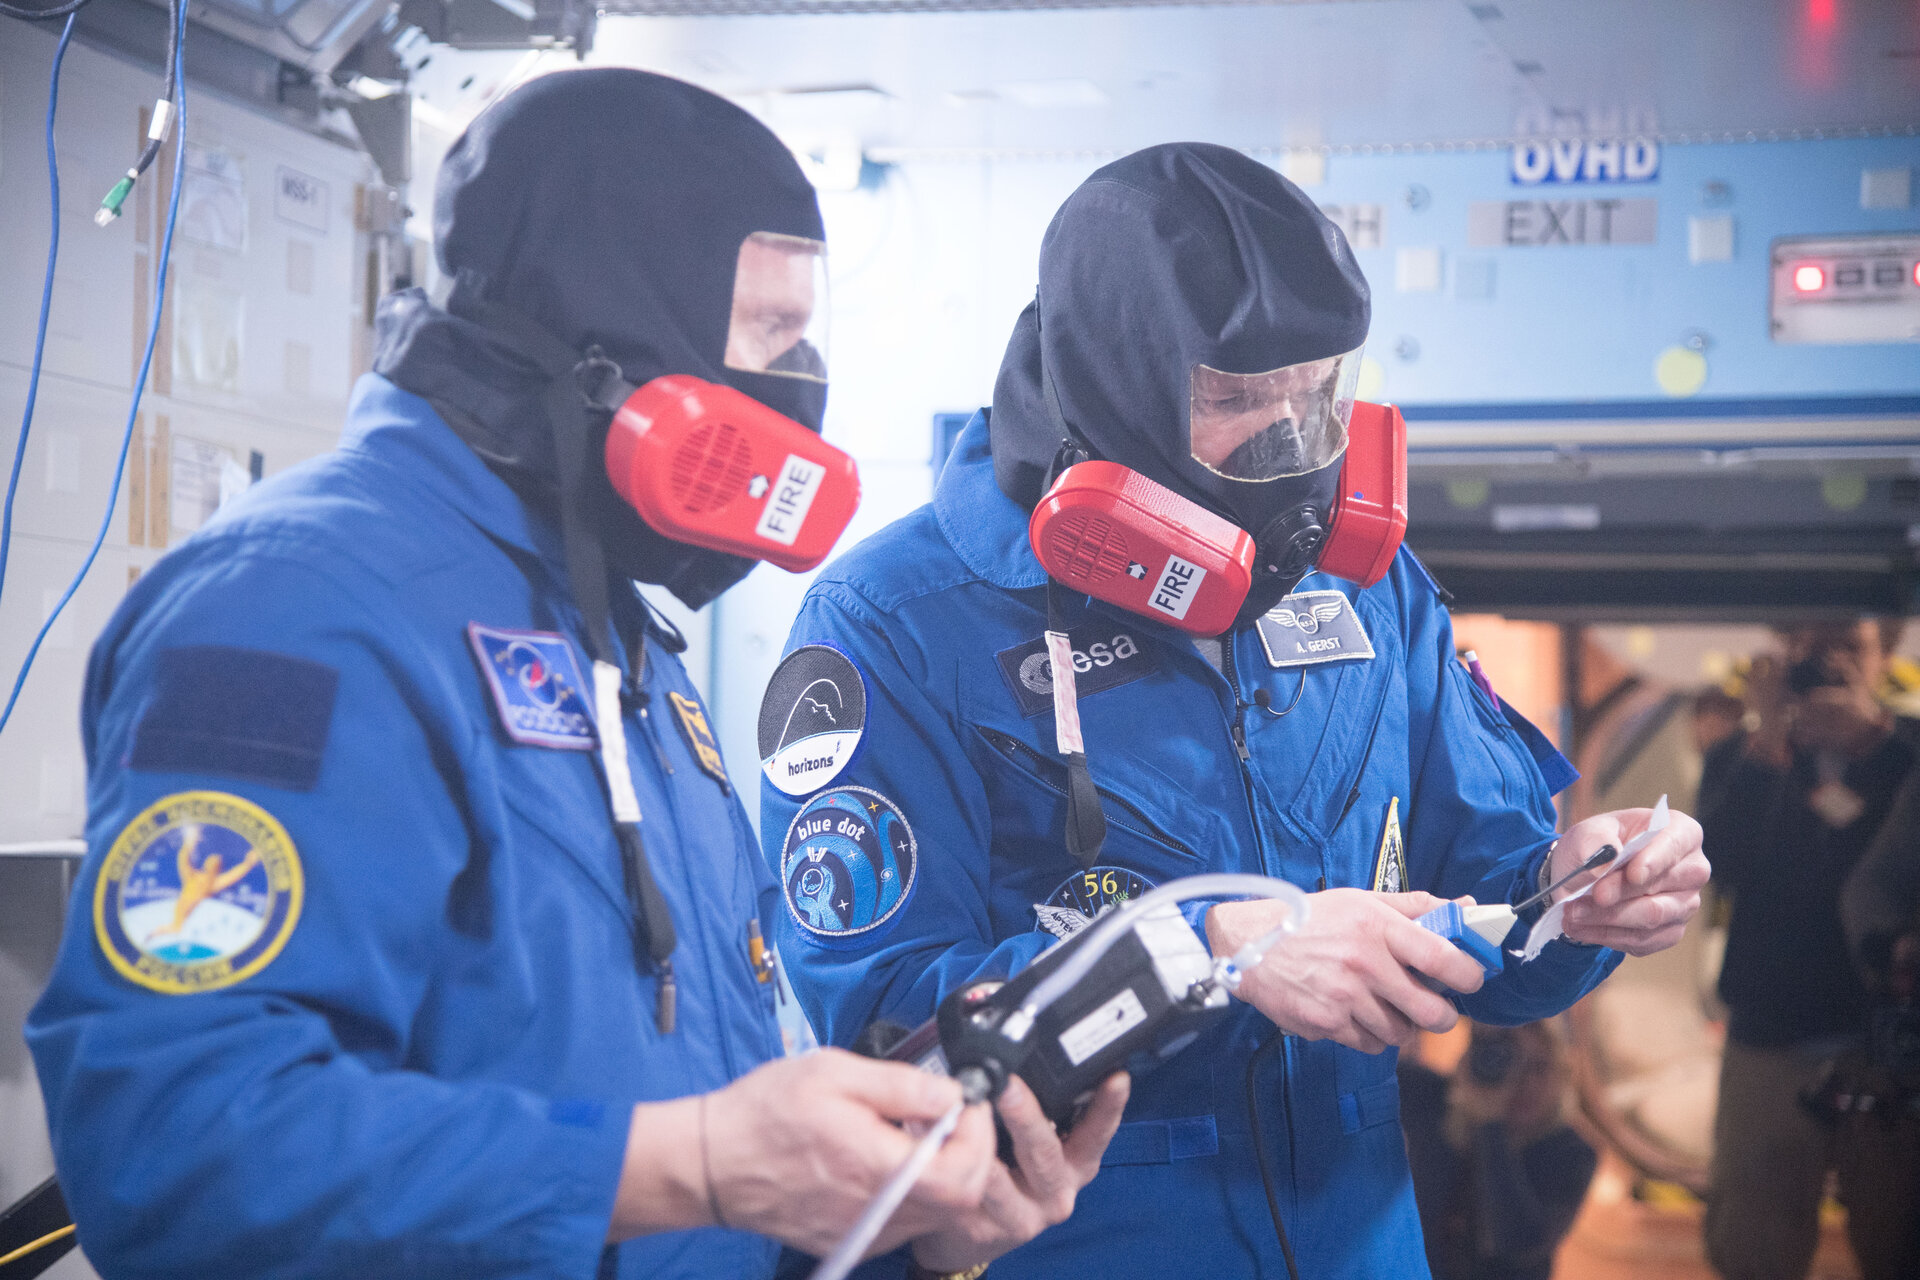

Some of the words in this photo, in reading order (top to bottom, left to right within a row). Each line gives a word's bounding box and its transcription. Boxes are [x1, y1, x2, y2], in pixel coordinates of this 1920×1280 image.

[1513, 138, 1658, 180] OVHD
[1505, 200, 1621, 246] EXIT
[767, 465, 812, 533] FIRE
[1154, 561, 1195, 611] FIRE
[1072, 634, 1139, 673] esa
[1296, 641, 1307, 653] A.
[1307, 637, 1341, 652] GERST
[787, 755, 834, 777] horizons
[797, 819, 832, 841] blue
[837, 817, 866, 842] dot
[1084, 871, 1118, 898] 56
